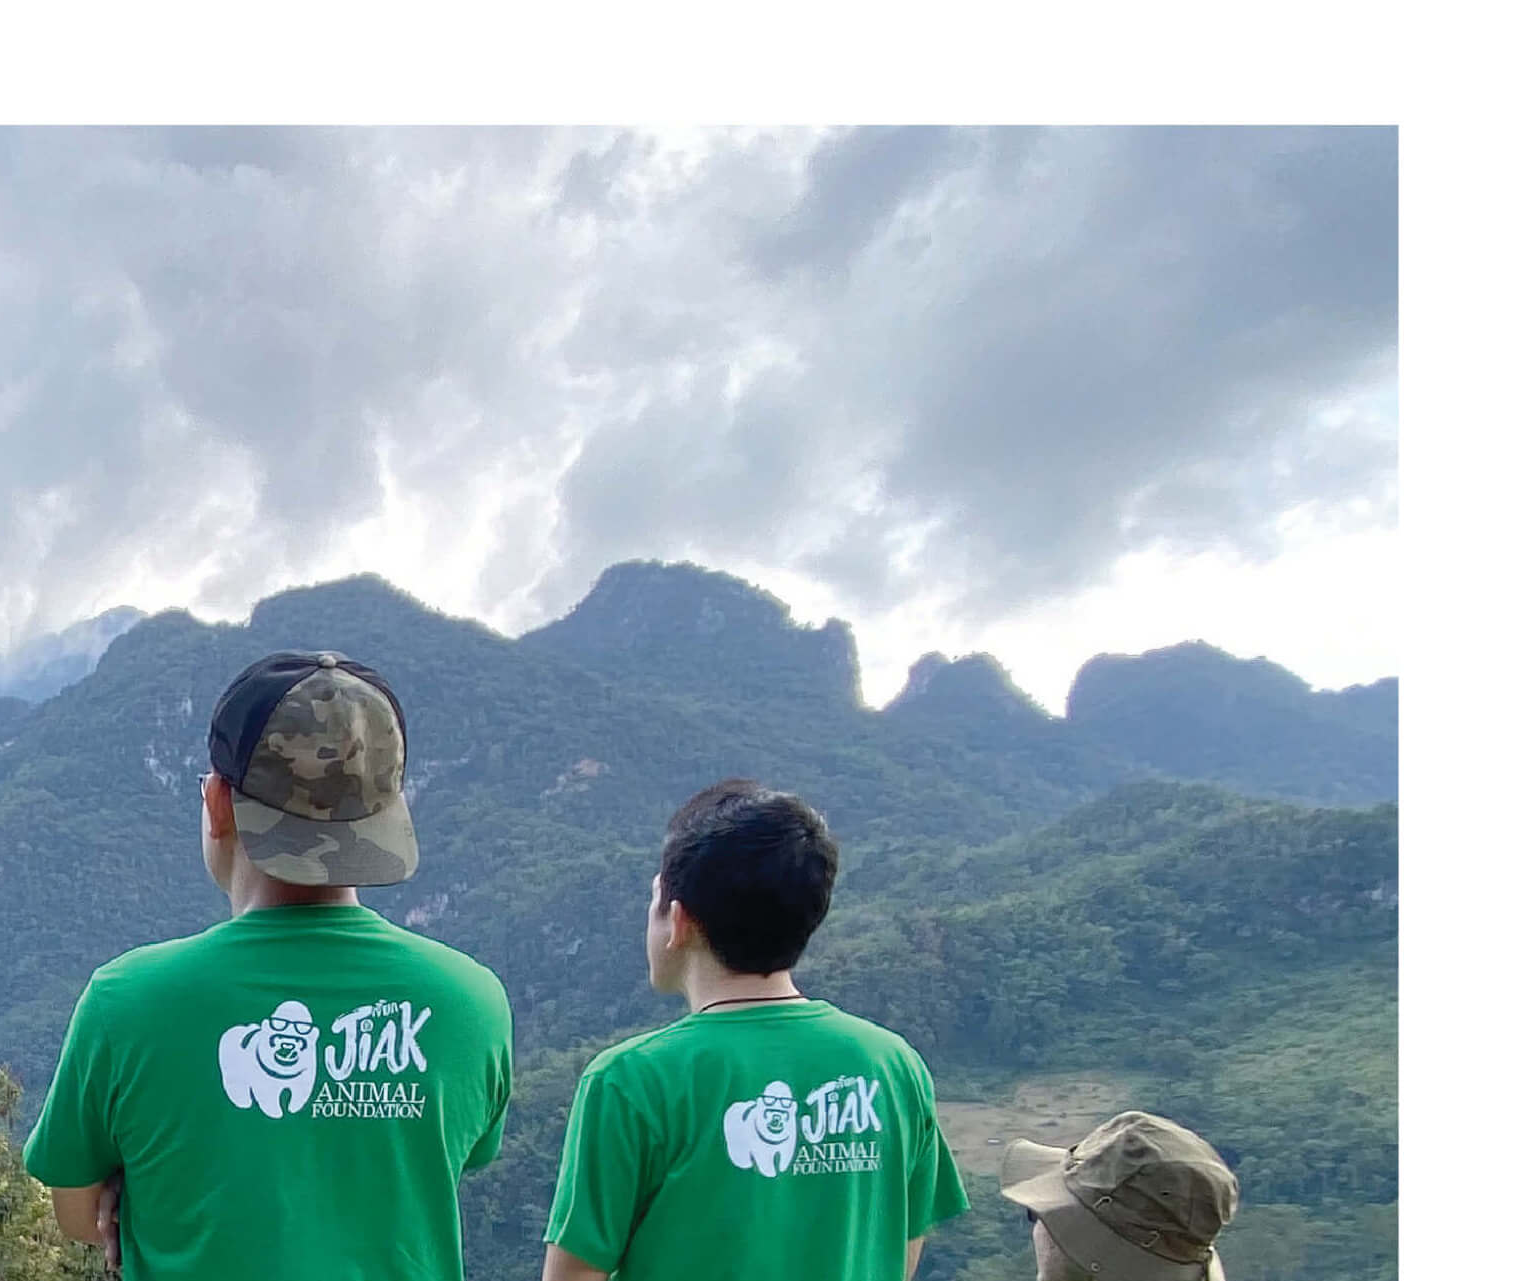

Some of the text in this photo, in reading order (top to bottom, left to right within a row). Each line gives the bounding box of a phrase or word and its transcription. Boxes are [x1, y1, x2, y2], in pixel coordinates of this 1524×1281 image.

[314, 1082, 426, 1104] ANIMAL
[311, 1102, 426, 1119] FOUNDATION
[796, 1141, 881, 1163] ANIMAL
[792, 1158, 881, 1176] FOUNDATION
